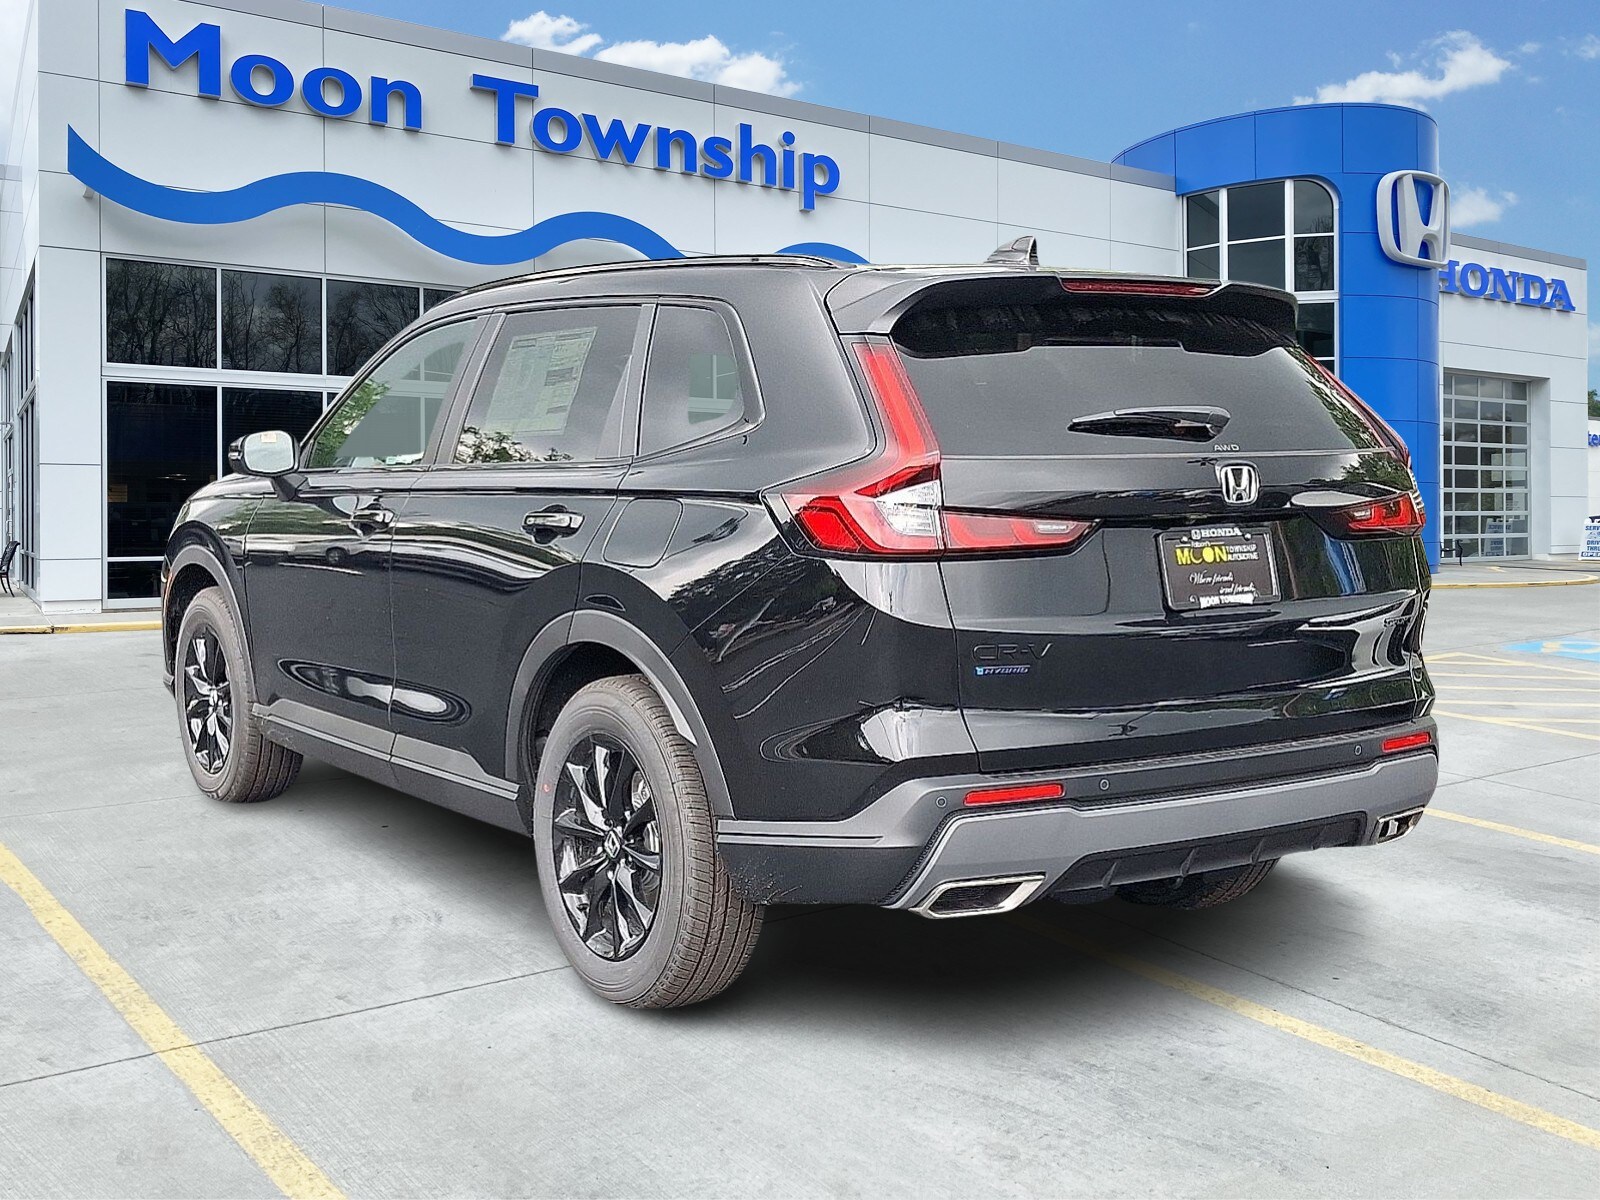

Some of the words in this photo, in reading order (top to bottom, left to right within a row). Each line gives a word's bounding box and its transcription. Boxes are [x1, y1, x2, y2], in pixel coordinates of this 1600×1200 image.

[125, 9, 422, 131] Moon
[470, 73, 841, 211] Township
[1438, 259, 1576, 312] HONDA
[1201, 527, 1243, 538] HONDA
[1175, 545, 1228, 565] MOON
[972, 643, 1053, 660] CR-V
